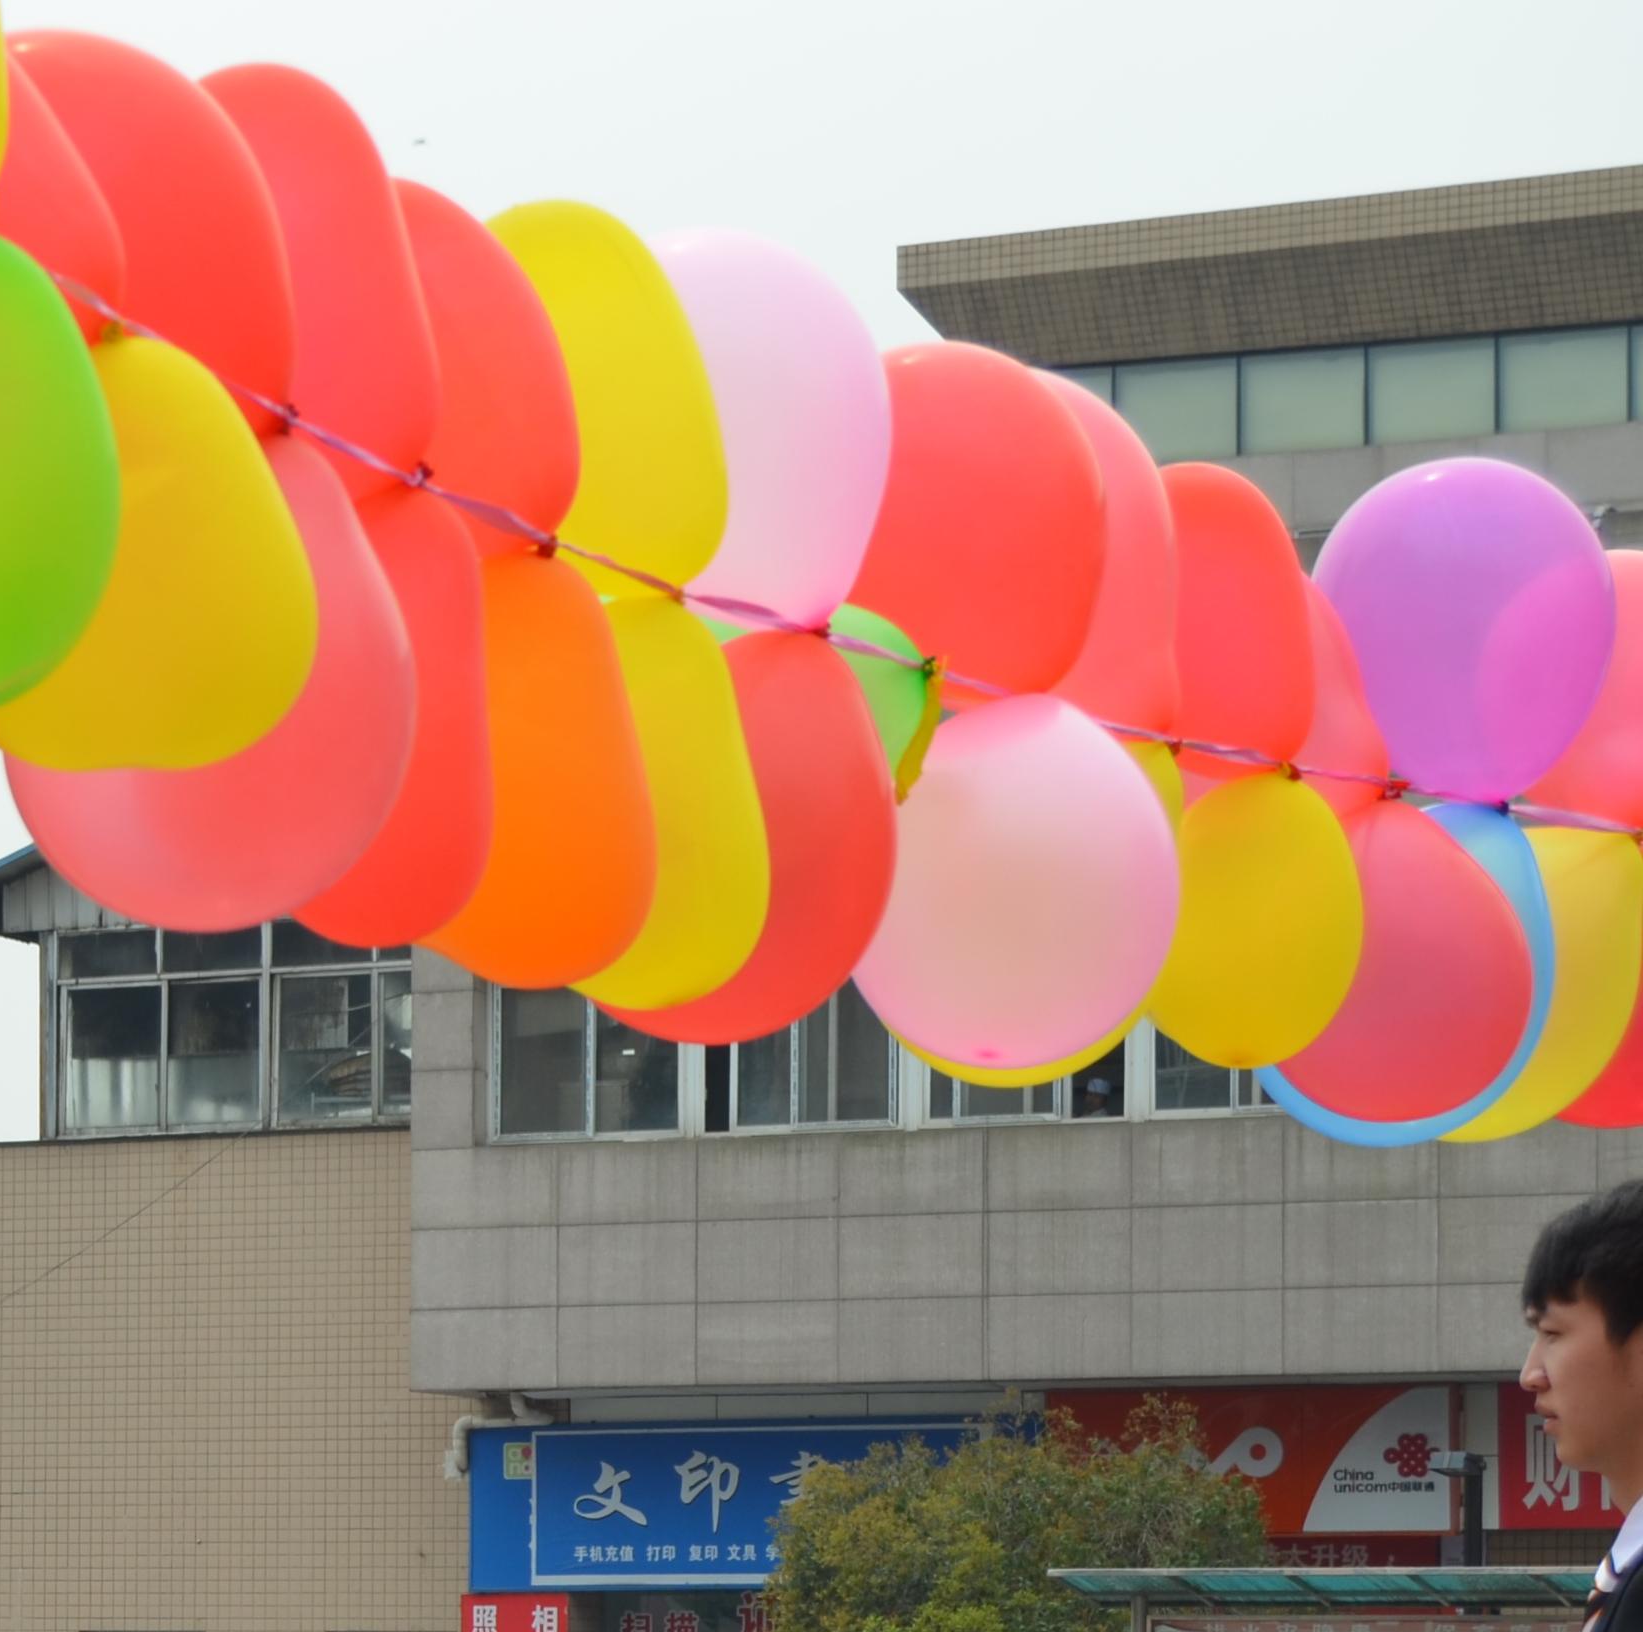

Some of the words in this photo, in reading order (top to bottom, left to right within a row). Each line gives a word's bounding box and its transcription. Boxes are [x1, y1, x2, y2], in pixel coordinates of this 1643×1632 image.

[1333, 1468, 1375, 1481] China
[573, 1545, 634, 1562] 手机充值
[646, 1544, 676, 1561] 打印
[689, 1544, 718, 1562] 复印
[727, 1544, 757, 1561] 文具
